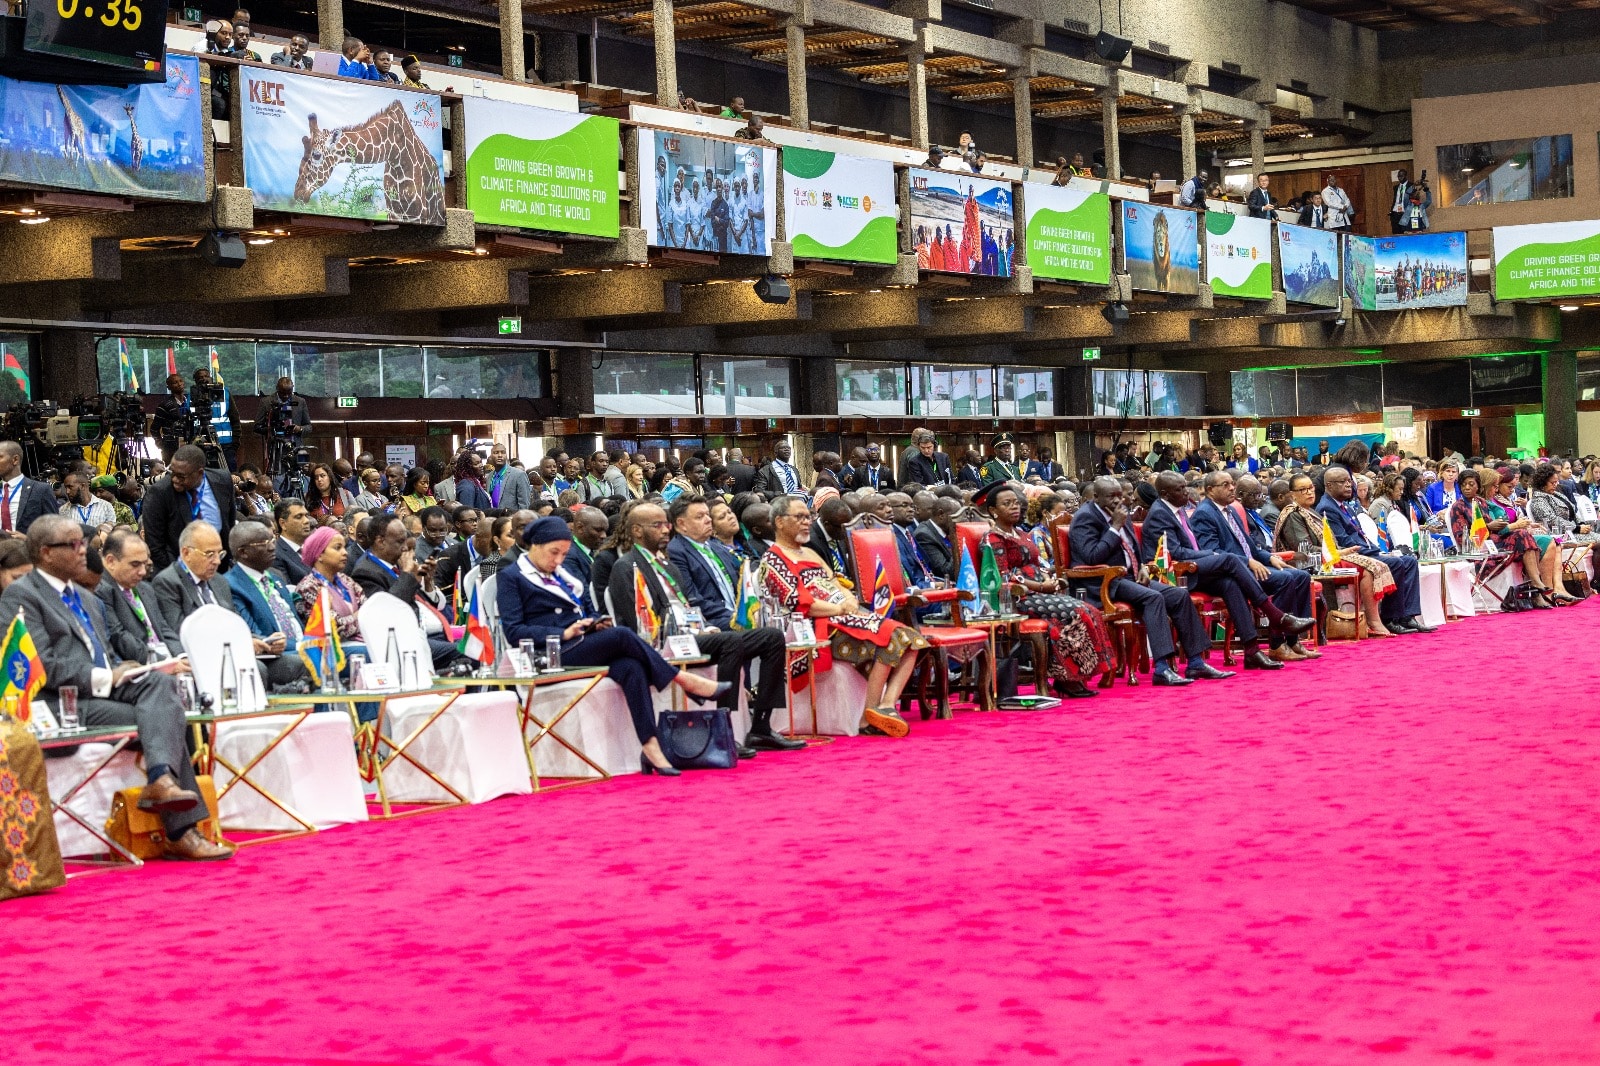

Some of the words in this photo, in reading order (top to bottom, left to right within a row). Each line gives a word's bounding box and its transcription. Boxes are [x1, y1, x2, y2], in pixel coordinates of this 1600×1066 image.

[248, 79, 285, 106] KICC
[494, 157, 525, 173] DRIVING
[527, 161, 553, 177] GREEN
[555, 165, 586, 181] GROWTH
[588, 169, 594, 182] &
[480, 175, 514, 192] CLIMATE
[516, 179, 549, 197] FINANCE
[550, 184, 591, 201] SOLUTIONS
[592, 189, 607, 204] FOR
[499, 198, 528, 213] AFRICA
[529, 201, 546, 216] AND
[547, 203, 563, 218] THE
[564, 205, 591, 221] WORLD
[1034, 240, 1052, 251] CLIMATE
[1072, 244, 1094, 256] SOLUTIONS
[1060, 257, 1070, 267] AND
[1070, 258, 1079, 268] THE
[1079, 260, 1094, 270] WORLD
[1524, 256, 1556, 267] DRIVING
[1558, 254, 1586, 264] GREEN
[1510, 269, 1544, 279] CLIMATE
[1546, 266, 1581, 276] FINANCE
[1529, 280, 1558, 290] AFRICA
[1560, 278, 1578, 288] AND
[1580, 277, 1596, 287] THE
